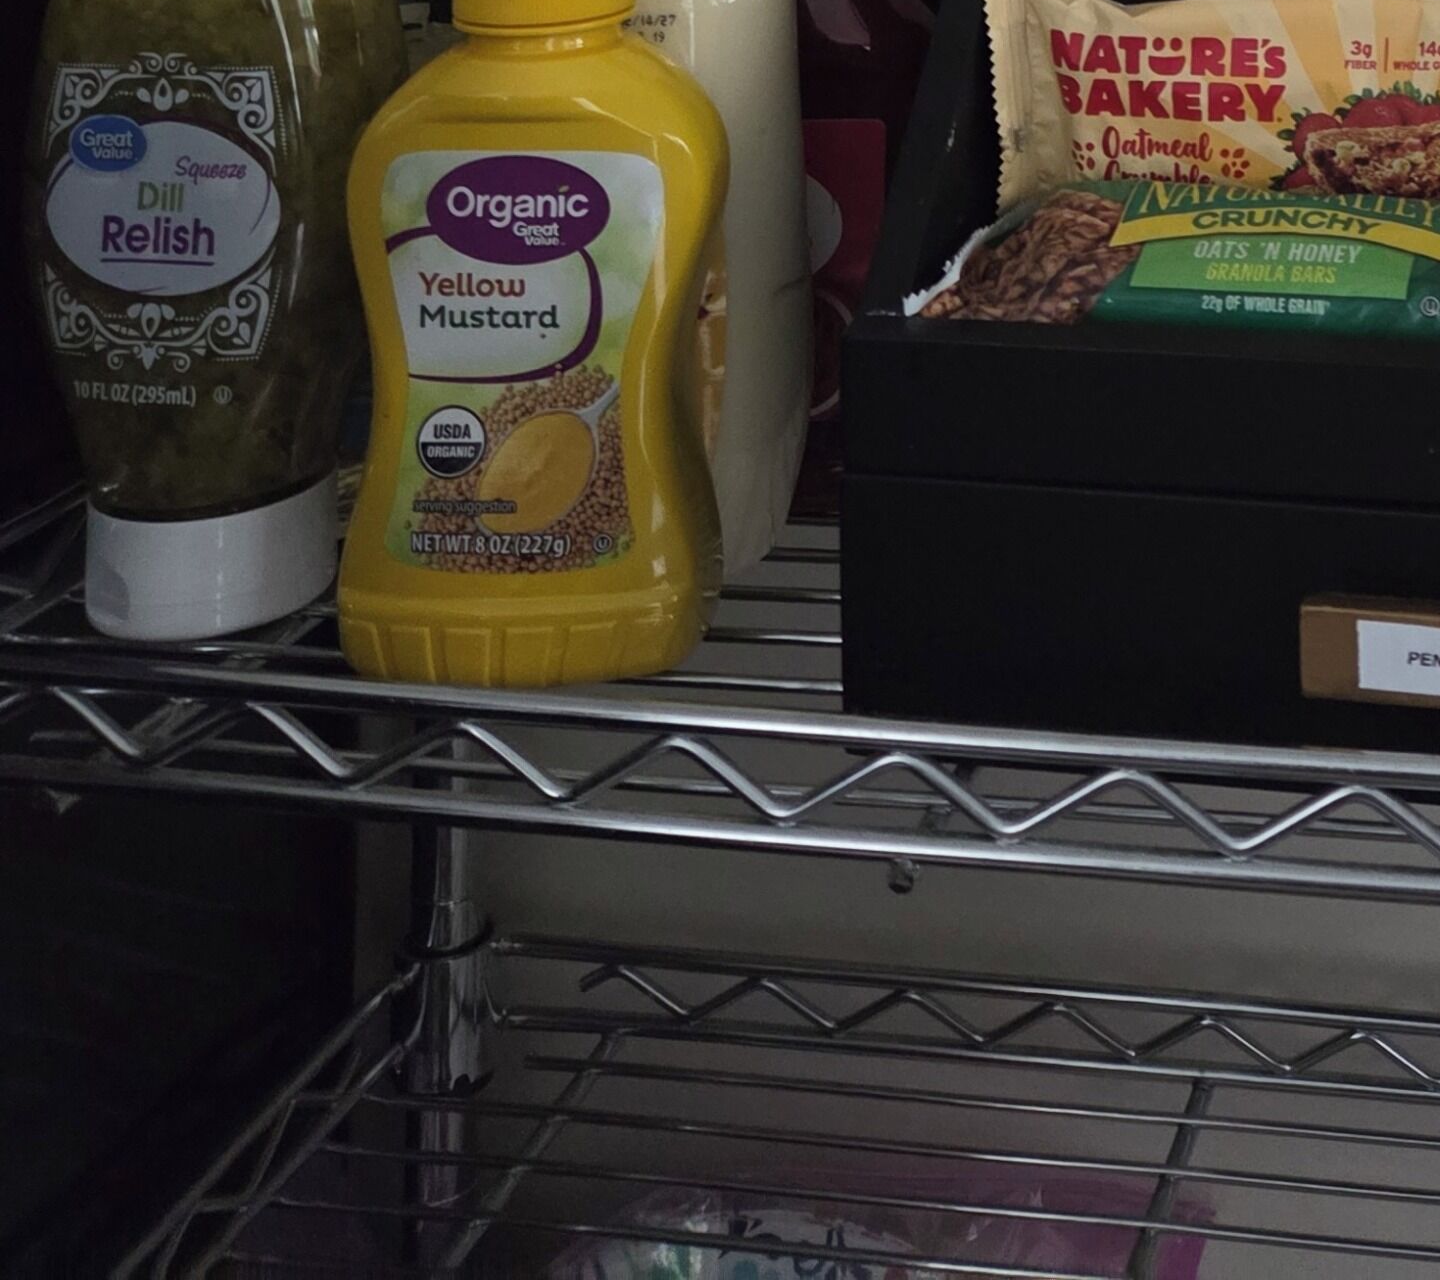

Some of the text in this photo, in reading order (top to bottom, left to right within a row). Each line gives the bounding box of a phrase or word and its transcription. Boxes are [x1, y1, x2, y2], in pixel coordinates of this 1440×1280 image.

[1350, 40, 1372, 58] 3g
[1344, 59, 1377, 70] FIBER
[1393, 60, 1430, 71] WHOLE
[1058, 73, 1286, 123] BAKERY
[79, 128, 134, 148] Great
[1102, 125, 1213, 162] Oatmeal
[92, 146, 134, 161] Value
[174, 155, 248, 185] Squeeze
[136, 180, 185, 212] Dill
[446, 185, 590, 228] Organic
[512, 221, 560, 237] Great
[1192, 208, 1380, 235] CRUNCHY
[101, 214, 215, 256] Relish
[524, 236, 560, 247] Value
[1194, 240, 1250, 260] OATS
[1286, 241, 1363, 264] HONEY
[418, 271, 526, 297] Yellow
[1206, 262, 1336, 285] GRANOLA BARS
[1201, 295, 1223, 313] 22g
[1225, 295, 1242, 311] OF
[1244, 296, 1285, 313] WHOLE
[419, 304, 560, 329] Mustard
[73, 380, 197, 407] 10 FL OZ (295mL)
[433, 423, 471, 439] USDA
[427, 444, 475, 458] ORGANIC
[415, 500, 516, 515] serving suggestion
[412, 533, 570, 557] NET WT 8 OZ (227g)
